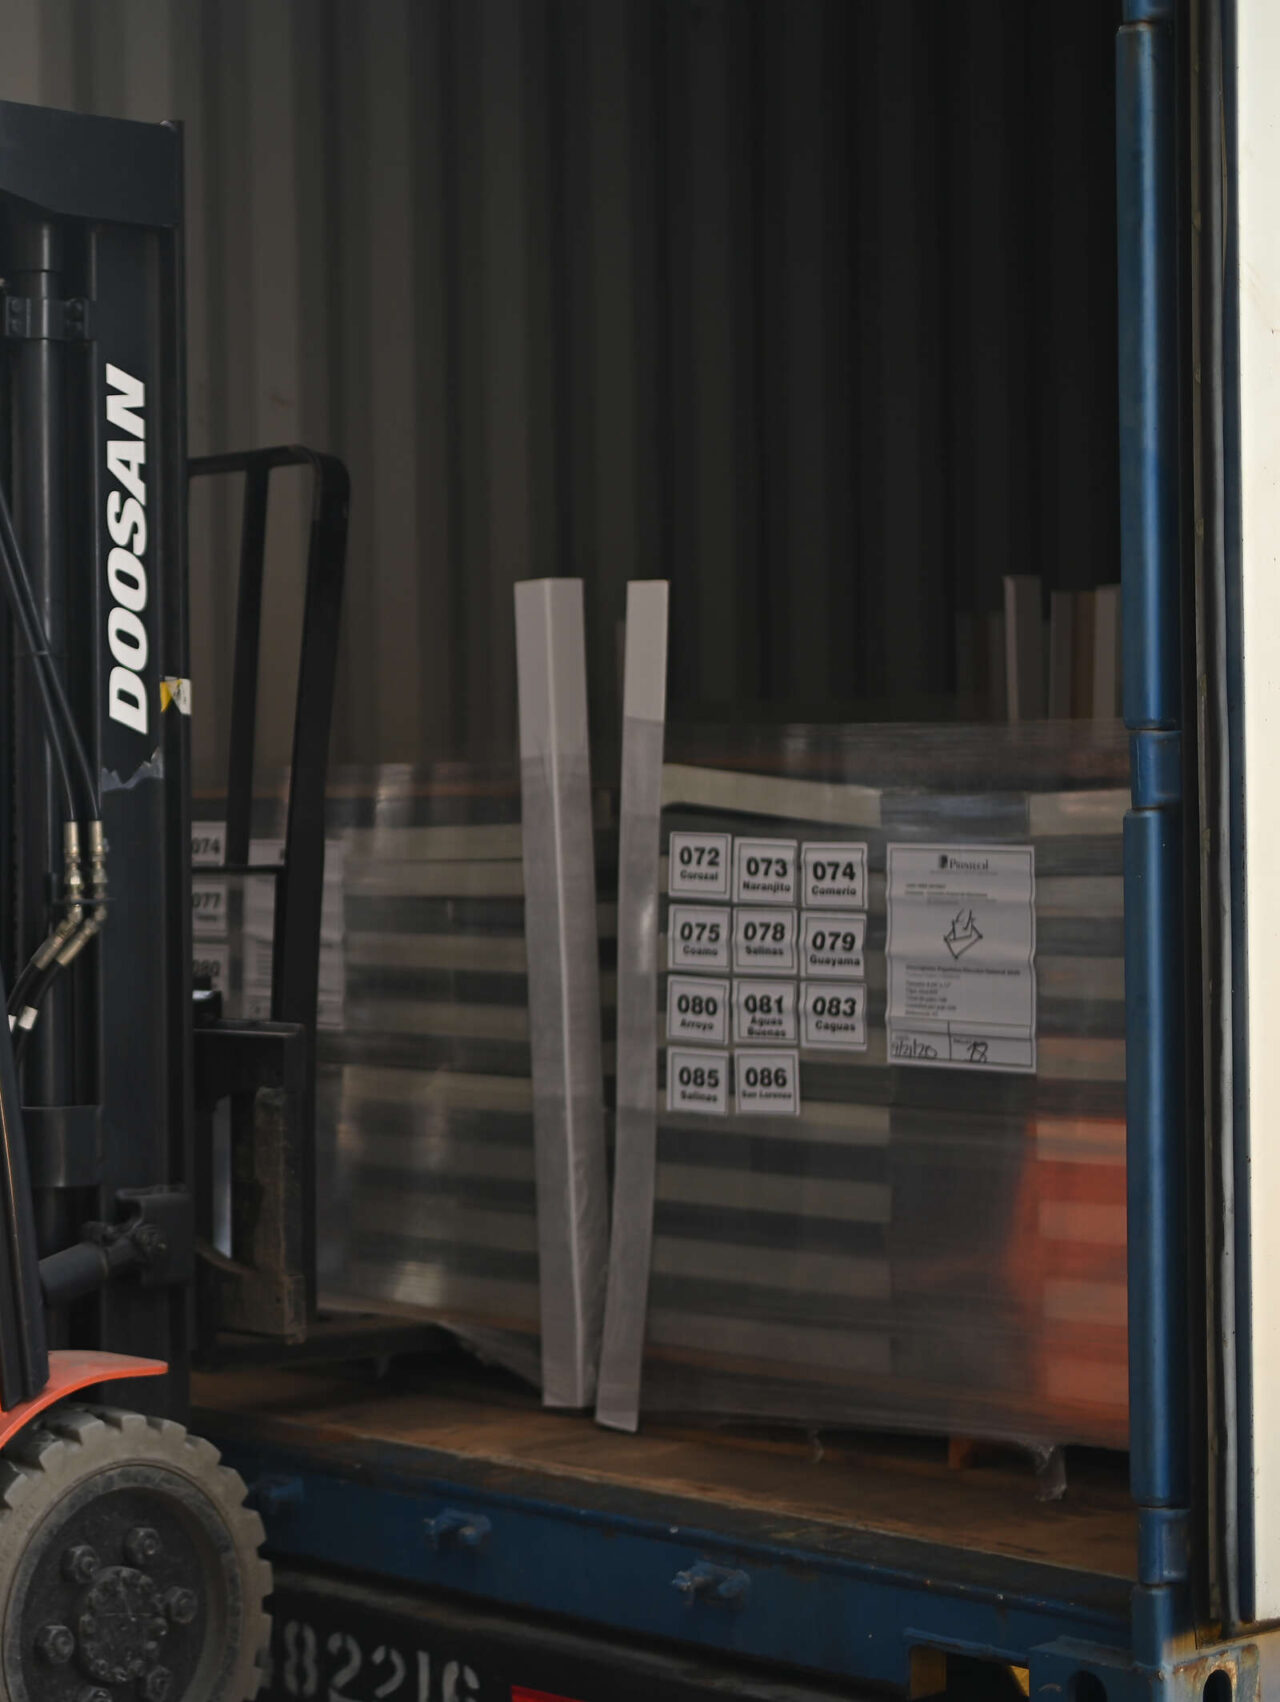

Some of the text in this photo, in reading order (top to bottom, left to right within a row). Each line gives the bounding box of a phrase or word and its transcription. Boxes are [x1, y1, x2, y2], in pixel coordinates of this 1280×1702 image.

[106, 363, 148, 734] DOOSAN
[679, 846, 720, 867] 072
[680, 870, 719, 881] Corozal
[746, 857, 788, 877] 073
[812, 861, 856, 881] 074
[742, 881, 791, 893] Naranjito
[679, 922, 721, 942] 075
[743, 922, 786, 942] 078
[811, 931, 856, 952] 079
[682, 945, 718, 956] Coamo
[745, 945, 784, 956] Salinas
[809, 955, 861, 967] Guayama
[677, 995, 718, 1016] 080
[744, 994, 784, 1014] 081
[812, 997, 857, 1017] 083
[680, 1019, 714, 1031] Arroyo
[747, 1027, 787, 1037] Buenas
[750, 1017, 783, 1027] Aguas
[815, 1021, 856, 1033] Caguas
[678, 1066, 720, 1088] 085
[745, 1067, 787, 1087] 086
[680, 1091, 718, 1102] Salinas
[742, 1090, 792, 1100] San Lorenzo
